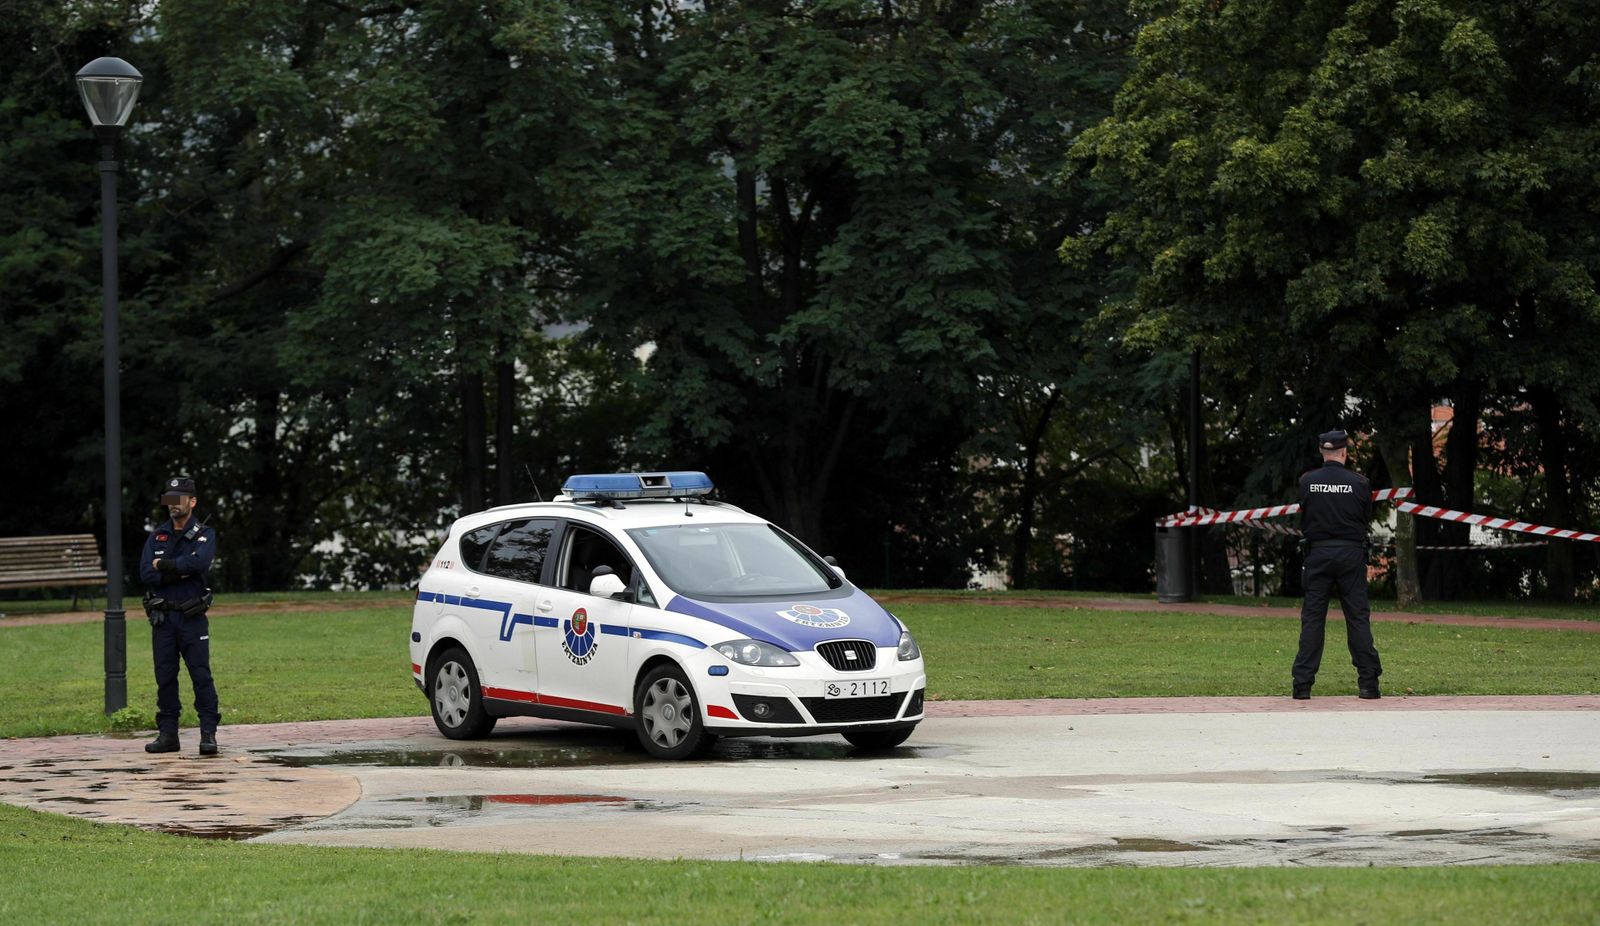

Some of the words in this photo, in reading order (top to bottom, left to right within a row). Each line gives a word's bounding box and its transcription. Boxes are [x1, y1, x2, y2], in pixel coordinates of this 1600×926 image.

[1310, 484, 1353, 493] ERTZAINTZA
[440, 560, 450, 569] 112
[561, 640, 598, 666] ERTZAINTZA
[850, 680, 888, 696] 2112
